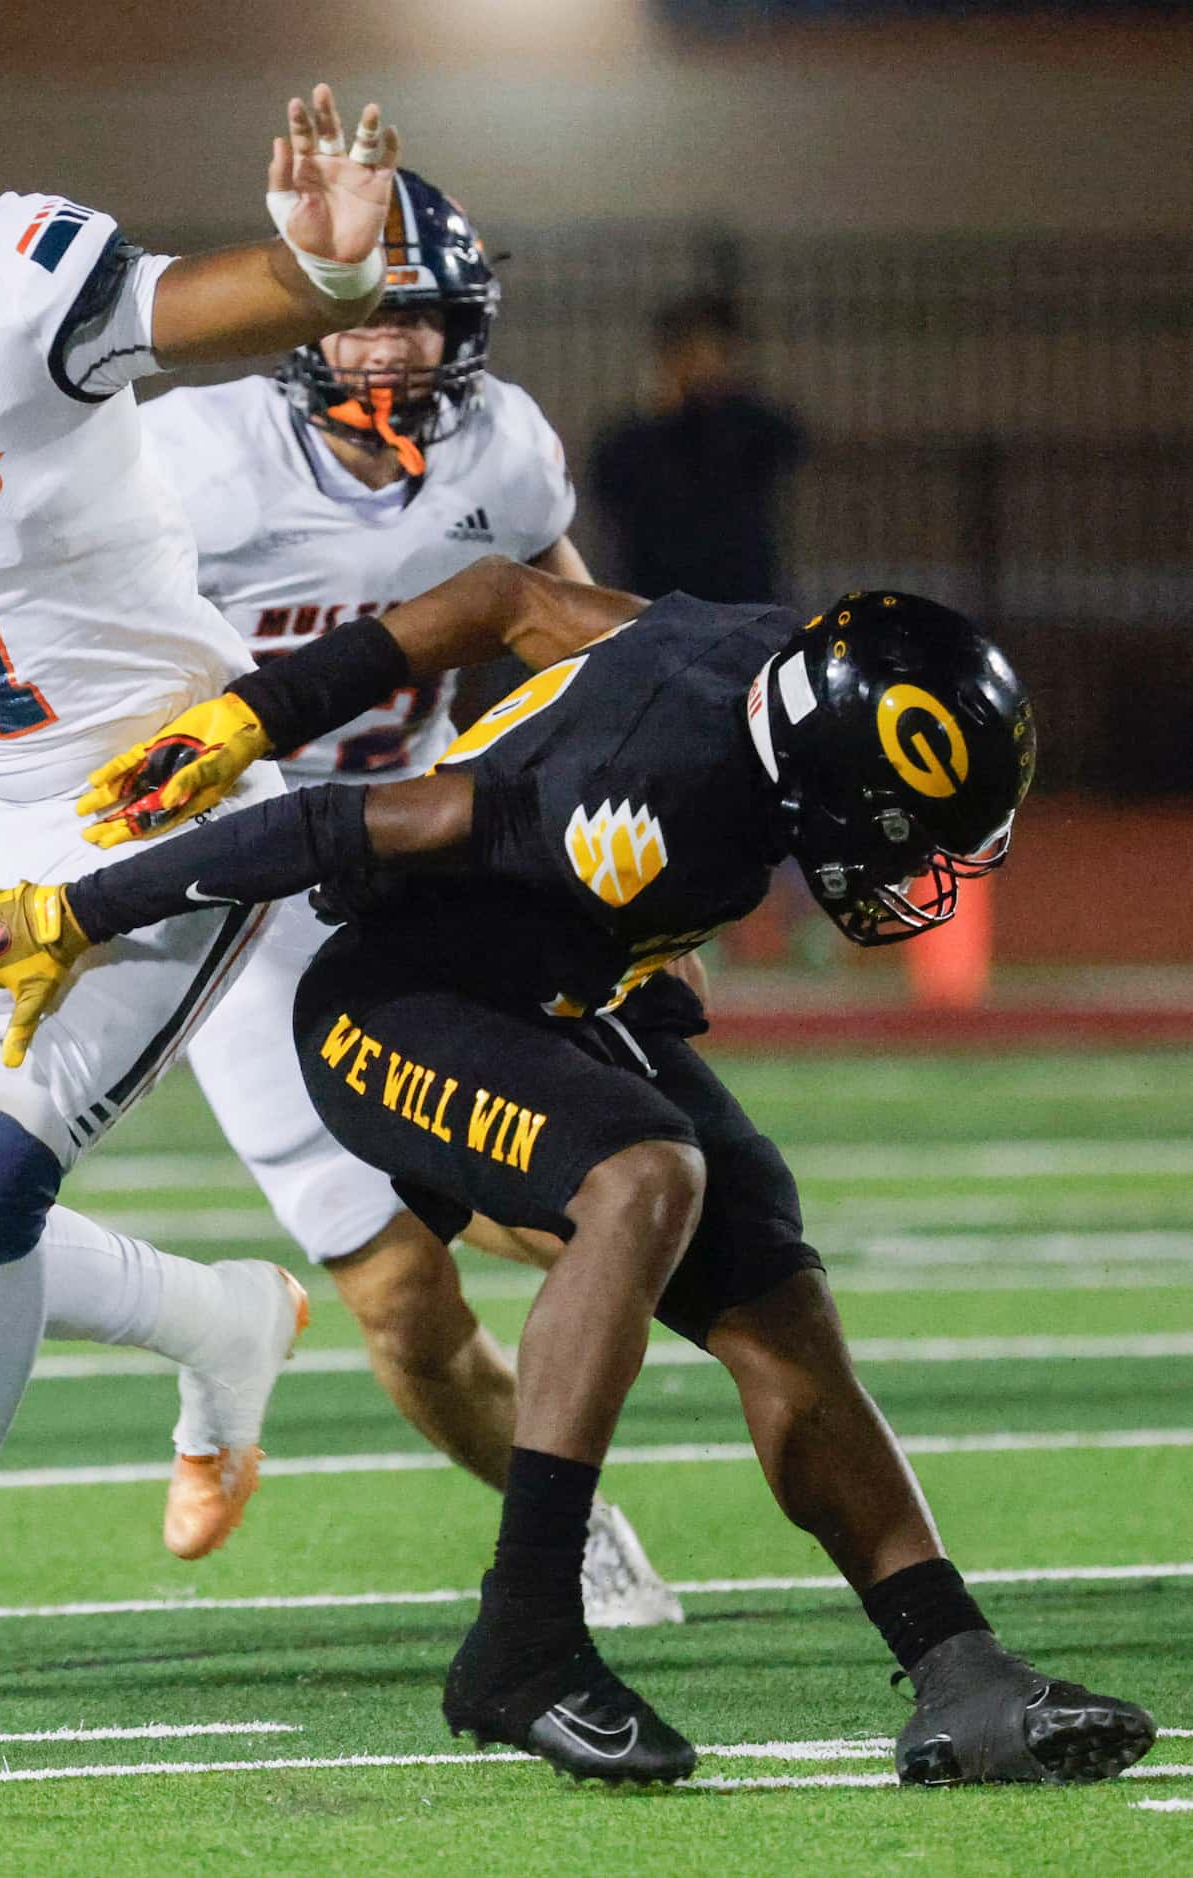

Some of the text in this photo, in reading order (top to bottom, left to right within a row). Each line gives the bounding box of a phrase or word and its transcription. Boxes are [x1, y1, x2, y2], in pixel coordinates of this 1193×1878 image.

[875, 683, 969, 798] G
[320, 1013, 547, 1173] WE WILL WIN
